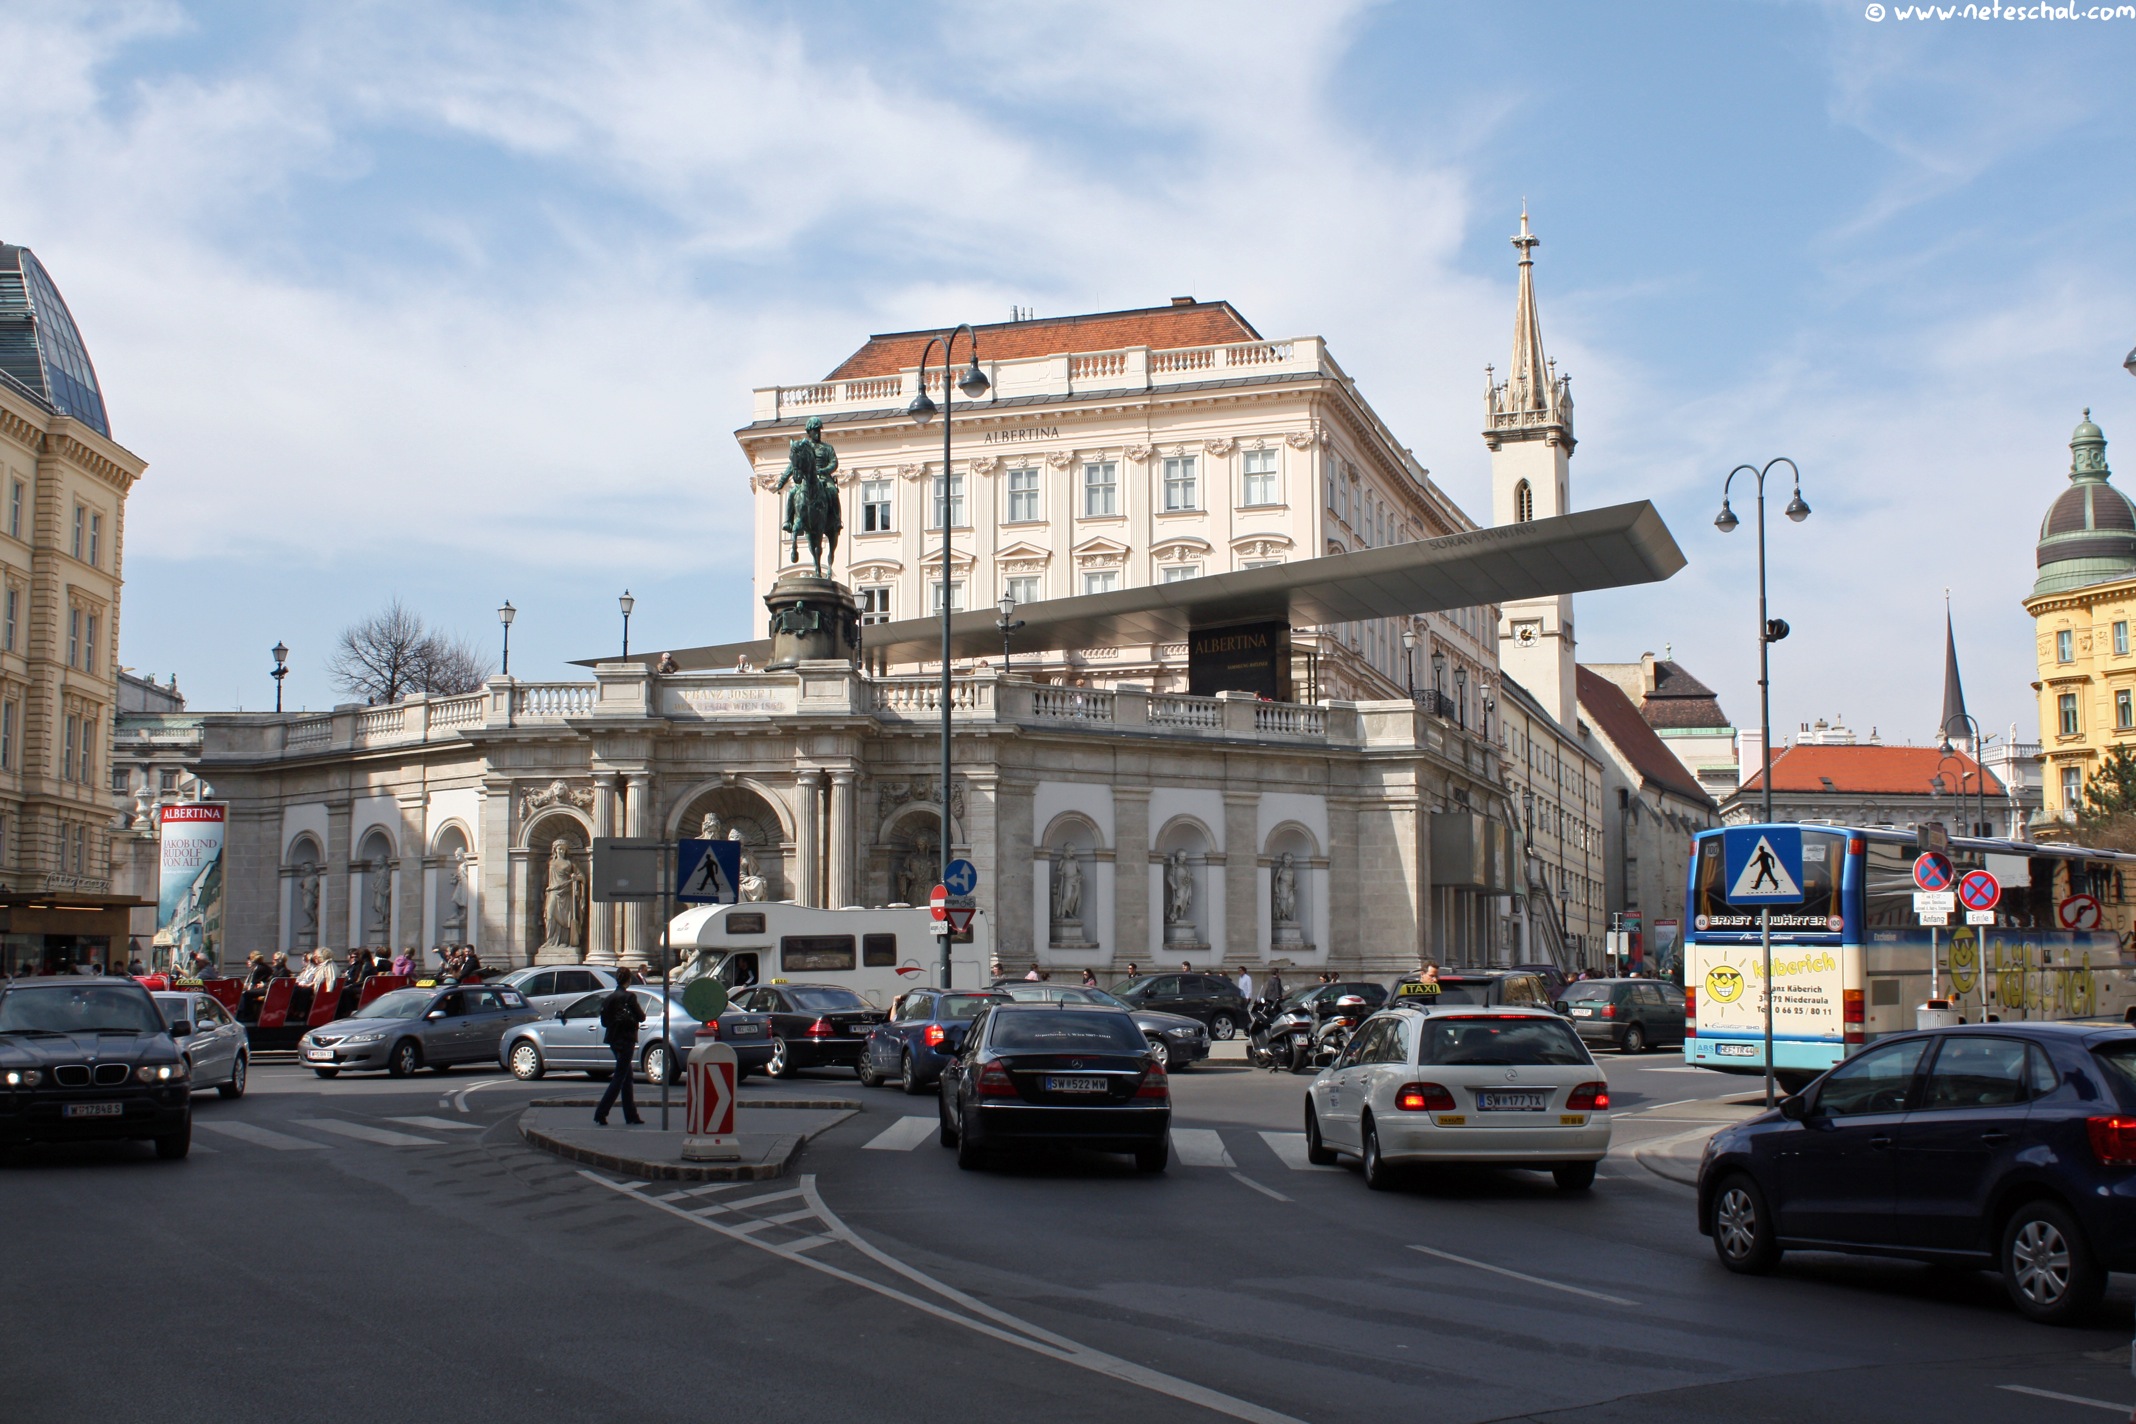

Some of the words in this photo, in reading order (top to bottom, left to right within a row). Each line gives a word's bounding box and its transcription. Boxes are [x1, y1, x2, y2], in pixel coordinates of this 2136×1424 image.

[984, 427, 1059, 444] ALBERTINA
[1429, 533, 1490, 551] SORAVIA
[1495, 525, 1537, 540] WING
[1195, 633, 1267, 655] ALBERTINA
[728, 689, 765, 700] JOSEF
[732, 701, 758, 711] WIEN
[163, 808, 221, 819] ALBERTINA
[164, 840, 190, 848] JAKOB
[192, 839, 217, 848] UND
[164, 849, 201, 858] RUDOLF
[164, 858, 180, 867] VON
[183, 858, 202, 867] ALT
[1710, 915, 1751, 926] ERNST
[1755, 914, 1827, 926] AWÄRTER
[1830, 919, 1841, 927] 100
[1922, 914, 1945, 924] Anfang
[1995, 938, 2096, 1017] käberich
[1407, 985, 1437, 994] TAXI
[1787, 985, 1822, 993] Käberich
[1759, 995, 1782, 1003] 372
[1784, 996, 1829, 1005] Niederaula
